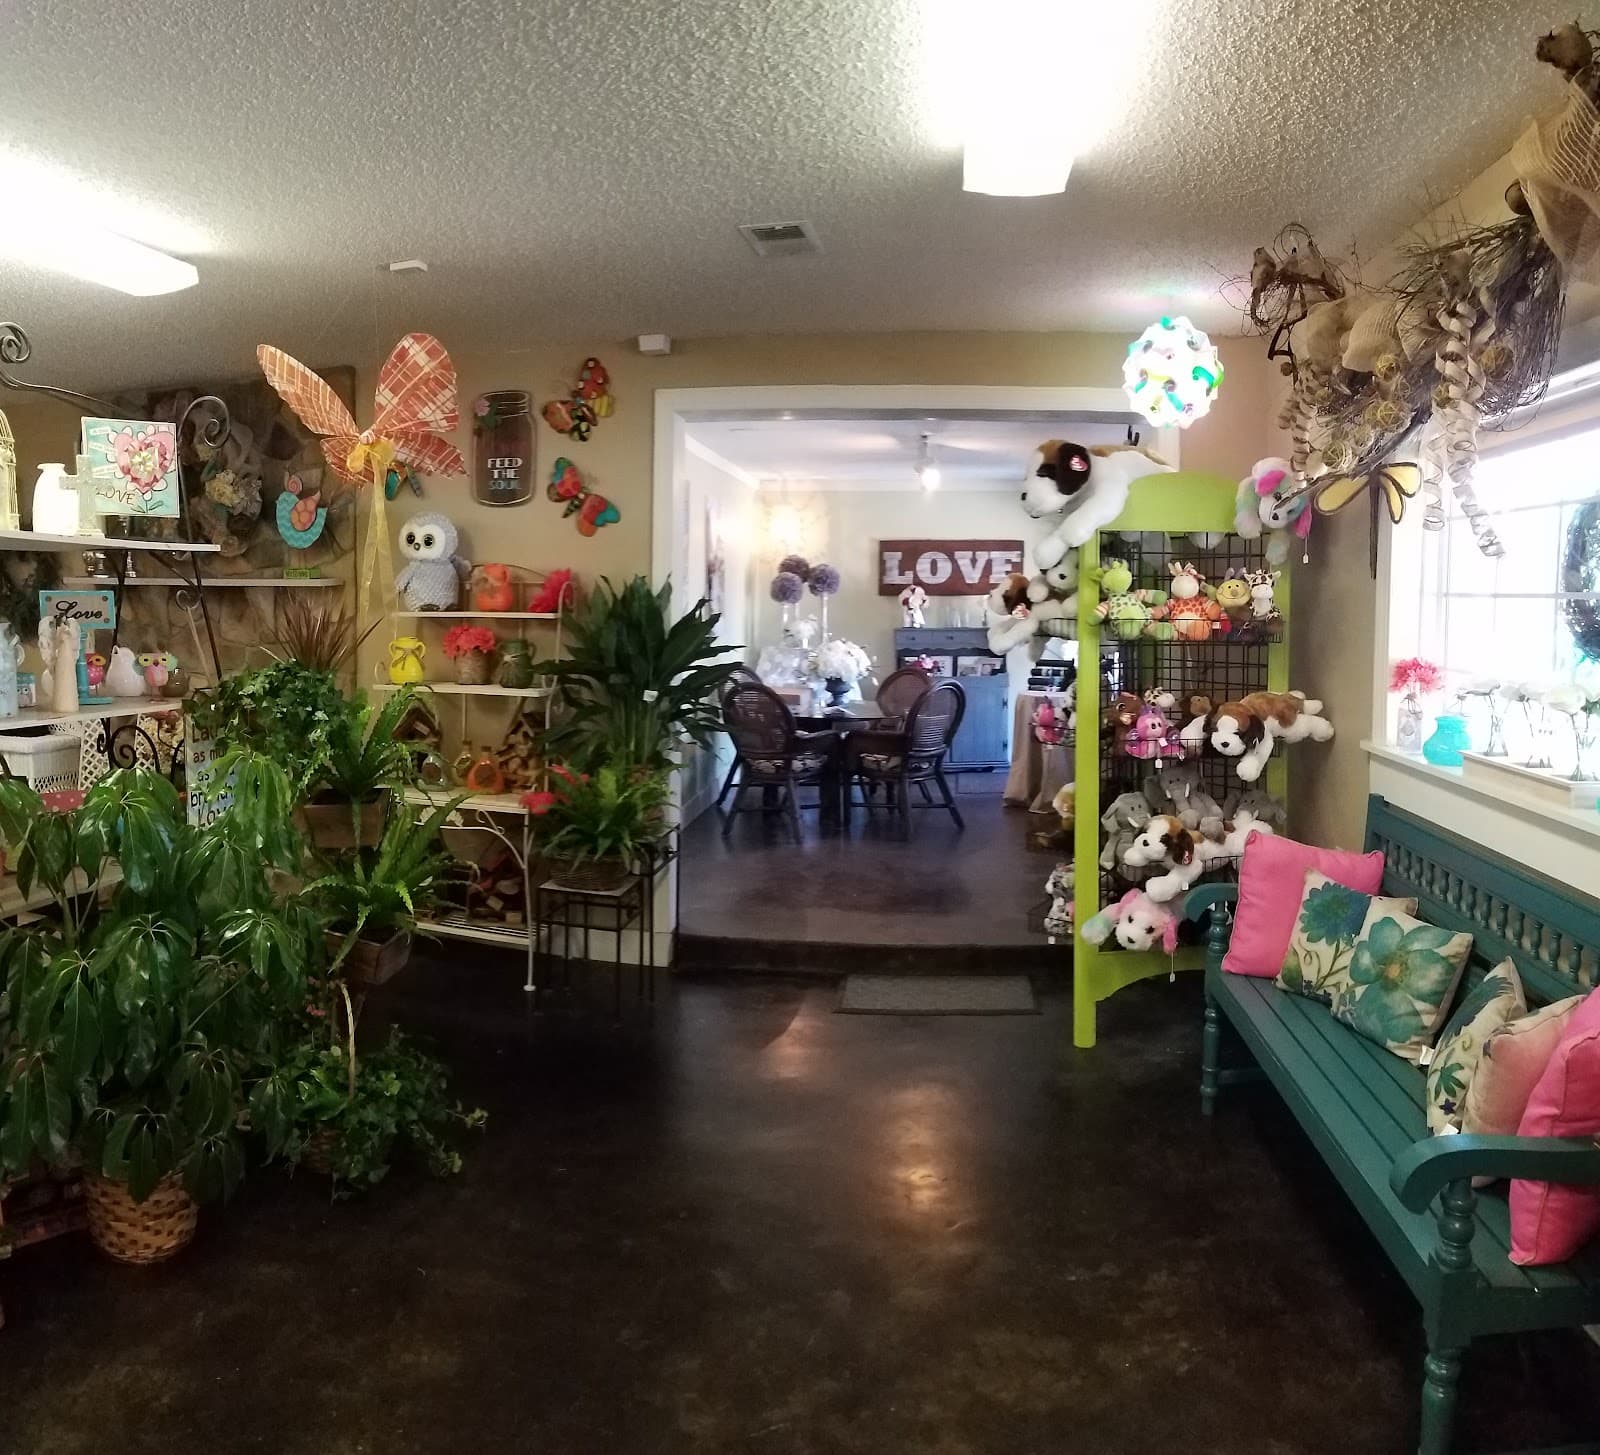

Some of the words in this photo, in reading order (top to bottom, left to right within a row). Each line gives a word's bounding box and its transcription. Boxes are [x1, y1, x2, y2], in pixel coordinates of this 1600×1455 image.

[488, 457, 523, 468] FEED
[490, 469, 520, 478] THE
[487, 480, 523, 490] SOUL
[882, 551, 1021, 584] LOVE
[54, 600, 103, 619] Love
[193, 752, 206, 763] as
